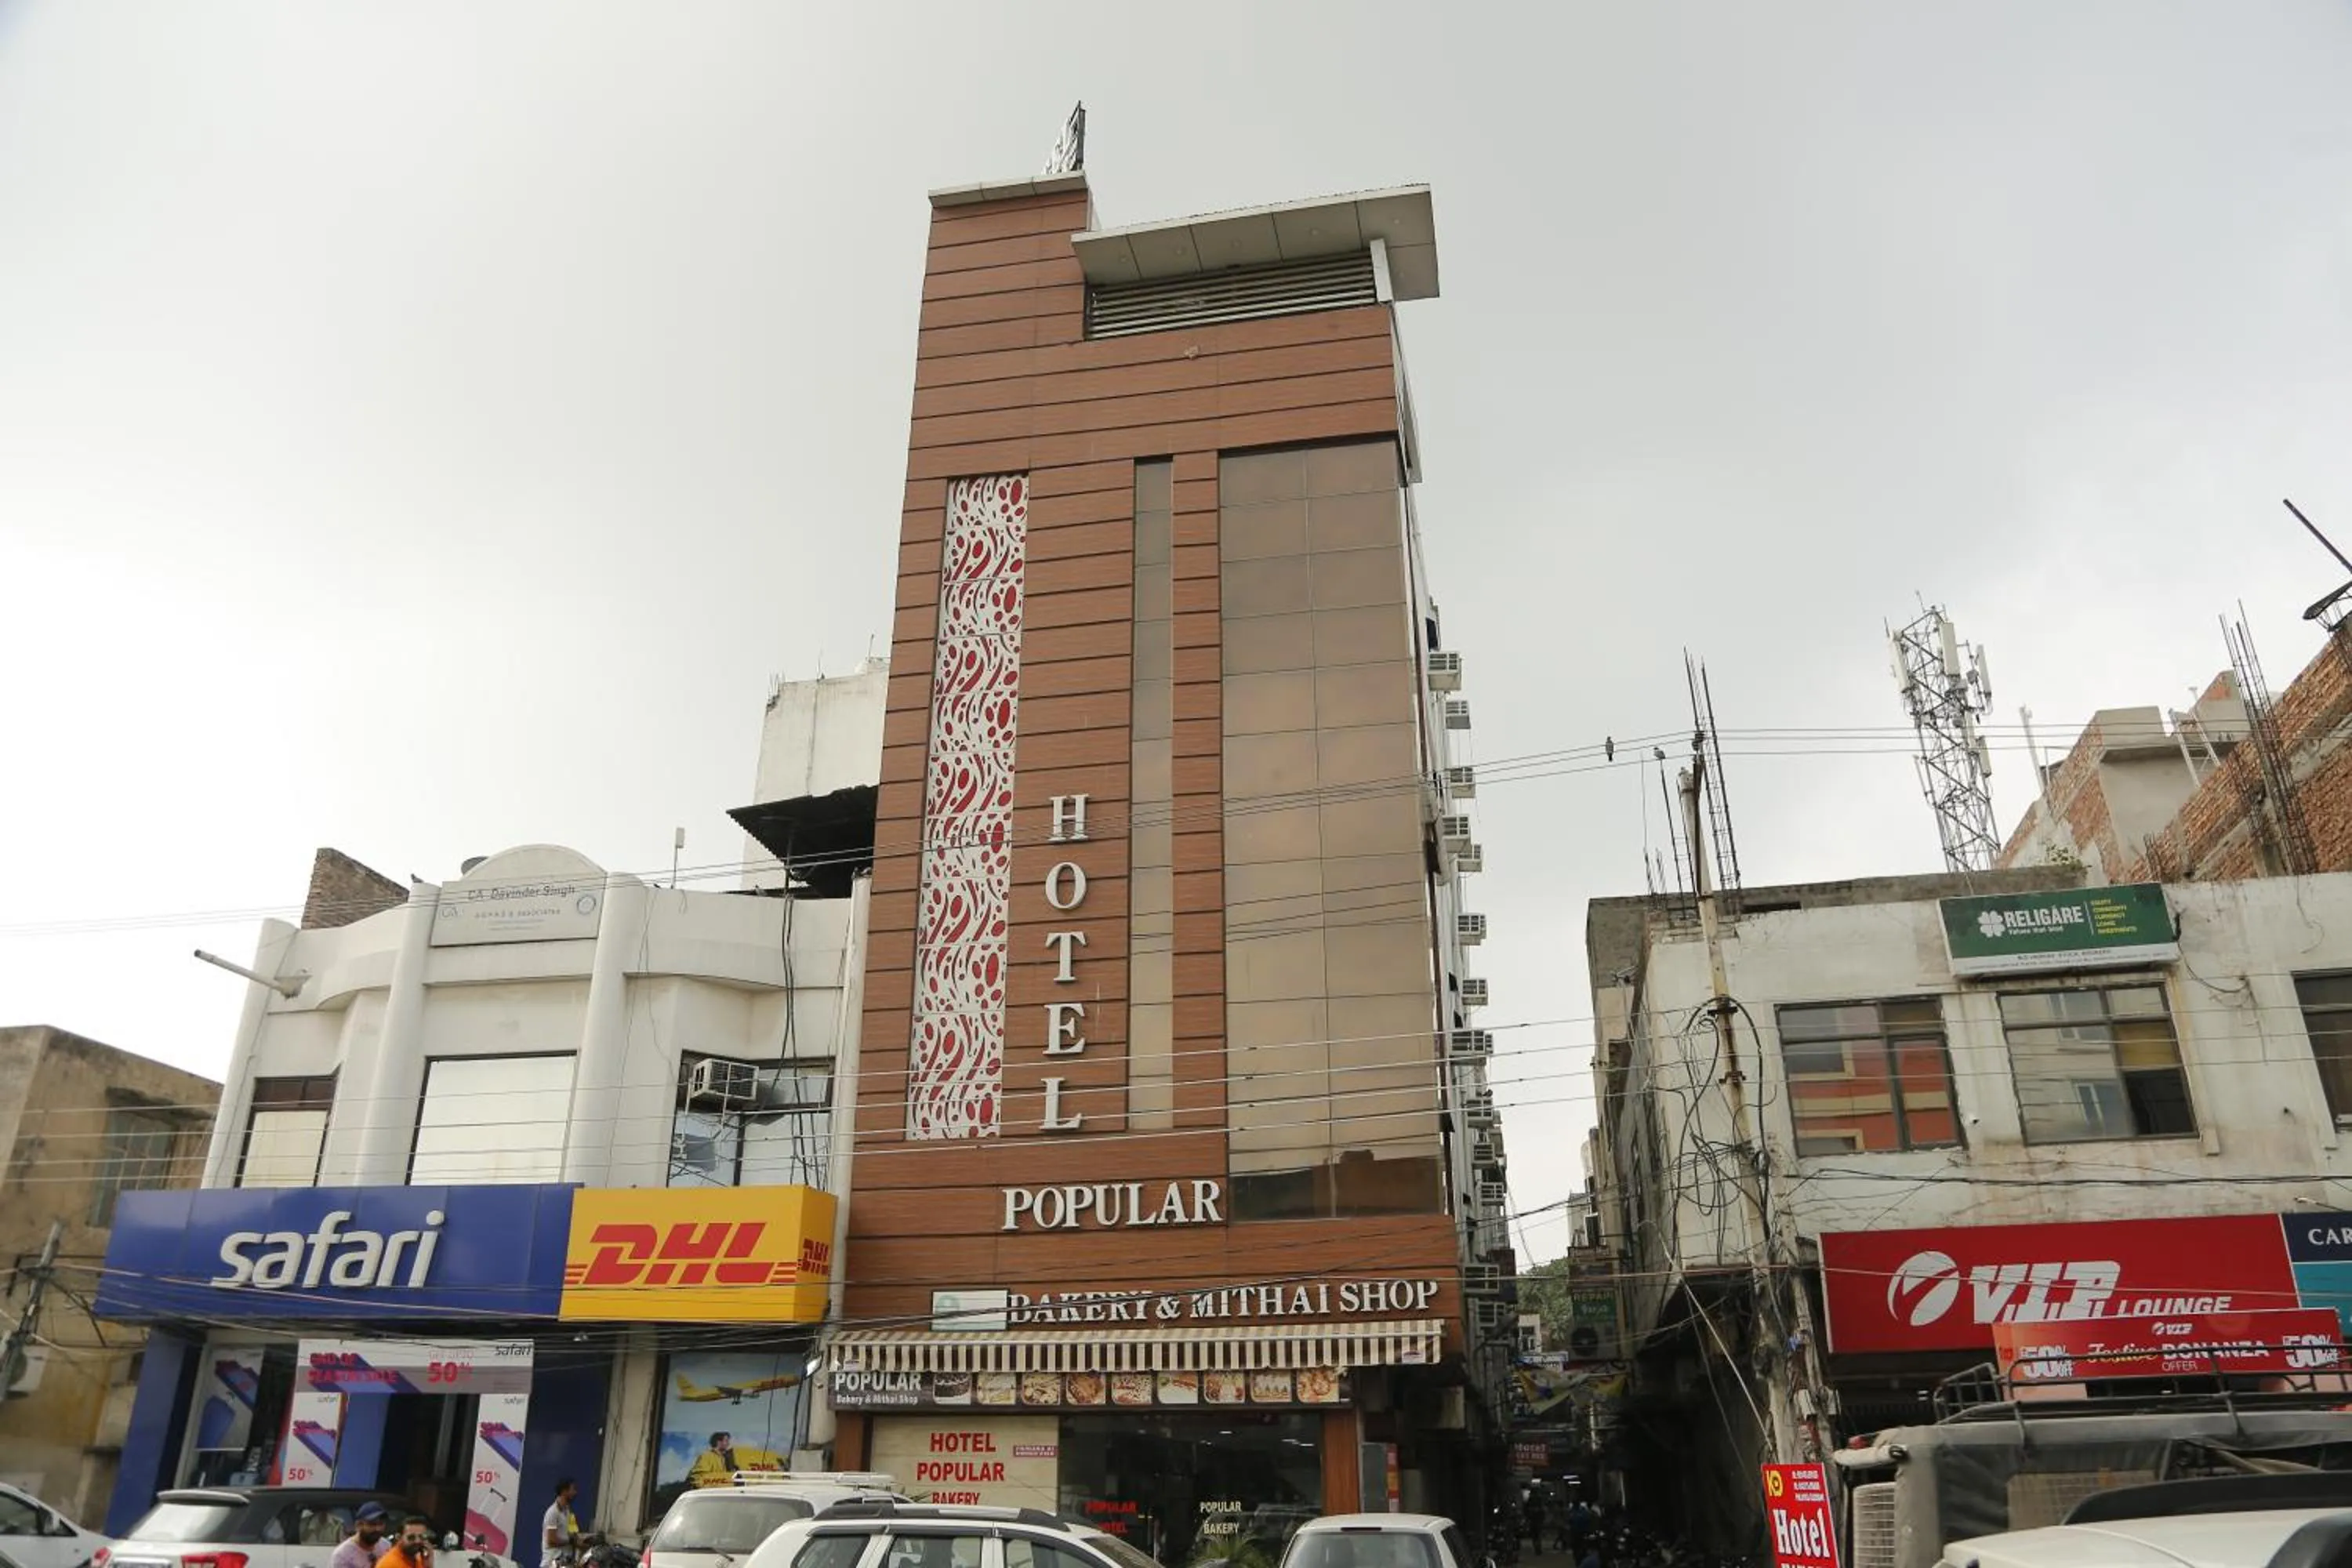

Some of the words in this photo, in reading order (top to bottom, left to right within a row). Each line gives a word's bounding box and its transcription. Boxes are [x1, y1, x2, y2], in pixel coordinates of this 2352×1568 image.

[2004, 906, 2084, 927] RELIGARE
[1039, 793, 1090, 1130] HOTEL
[1002, 1180, 1224, 1230] POPULAR
[210, 1210, 445, 1288] safari
[583, 1222, 775, 1284] DHL
[1007, 1290, 1153, 1323] BAKERY
[1155, 1295, 1181, 1319] &
[1189, 1283, 1331, 1319] MITHAI
[1339, 1279, 1439, 1314] SHOP
[1969, 1261, 2121, 1323] VIP
[2118, 1296, 2232, 1316] LOUNGE
[834, 1373, 922, 1392] POPULAR
[930, 1432, 996, 1453] HOTEL
[916, 1462, 1005, 1482] POPULAR
[931, 1491, 981, 1505] BAKERY
[1200, 1501, 1242, 1513] POPULAR
[1203, 1522, 1240, 1534] BAKERY
[1772, 1508, 1831, 1559] Hotel
